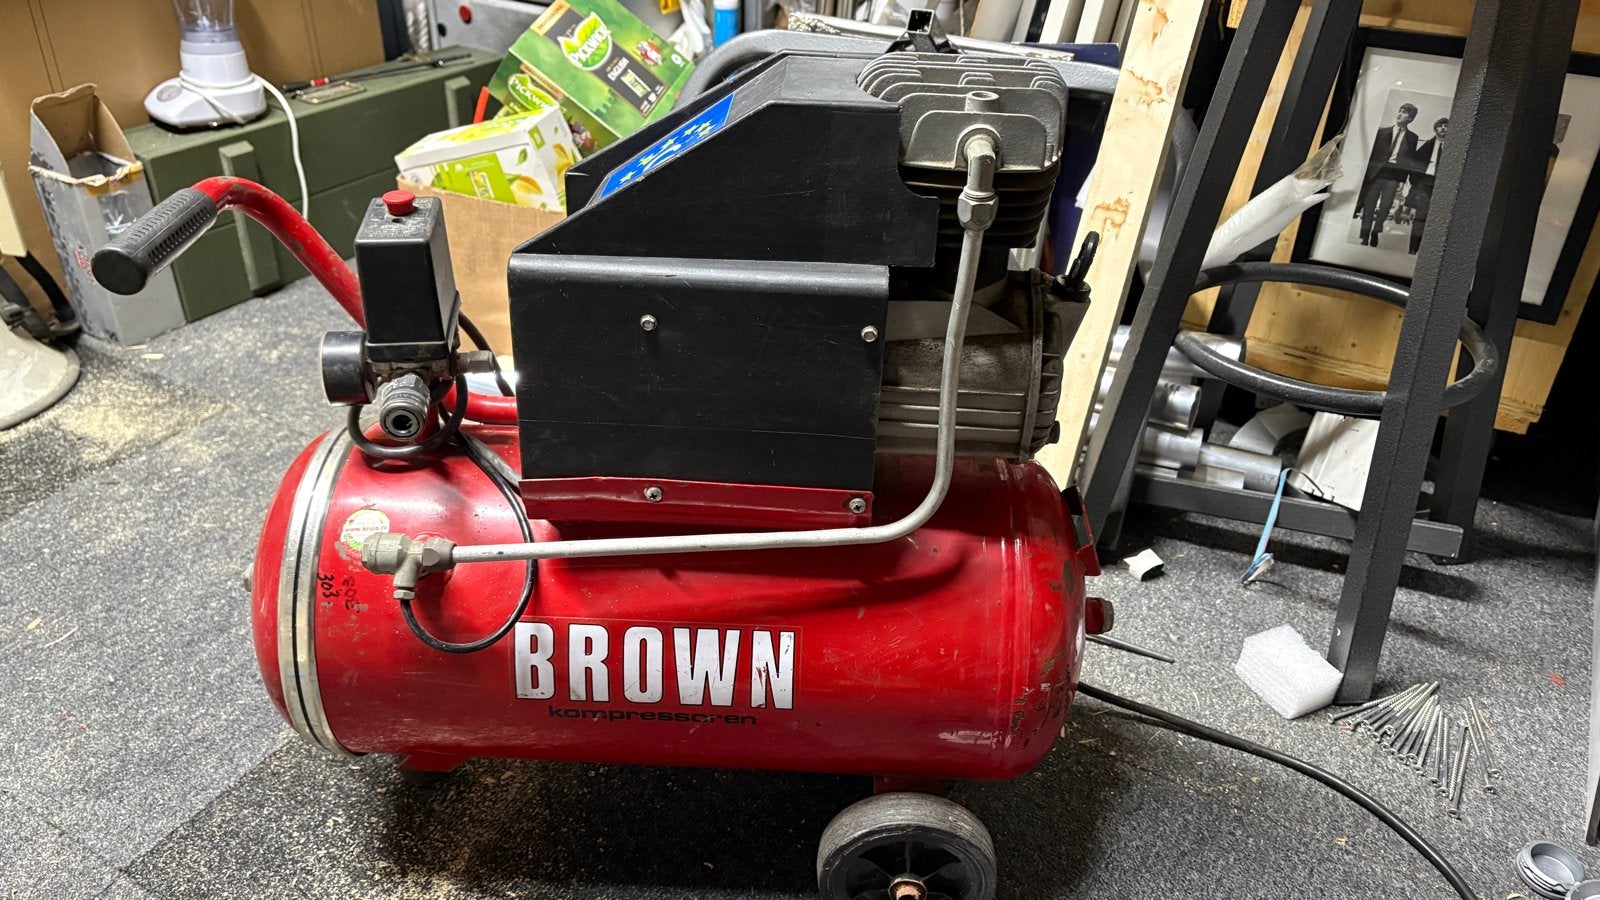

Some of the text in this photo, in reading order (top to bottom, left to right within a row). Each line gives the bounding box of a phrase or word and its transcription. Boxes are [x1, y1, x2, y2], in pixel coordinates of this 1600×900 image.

[568, 25, 612, 68] PICKWICK
[508, 76, 546, 108] PICKWI
[317, 573, 340, 598] 303
[513, 620, 796, 710] BROWN
[548, 704, 757, 726] kompressoren
